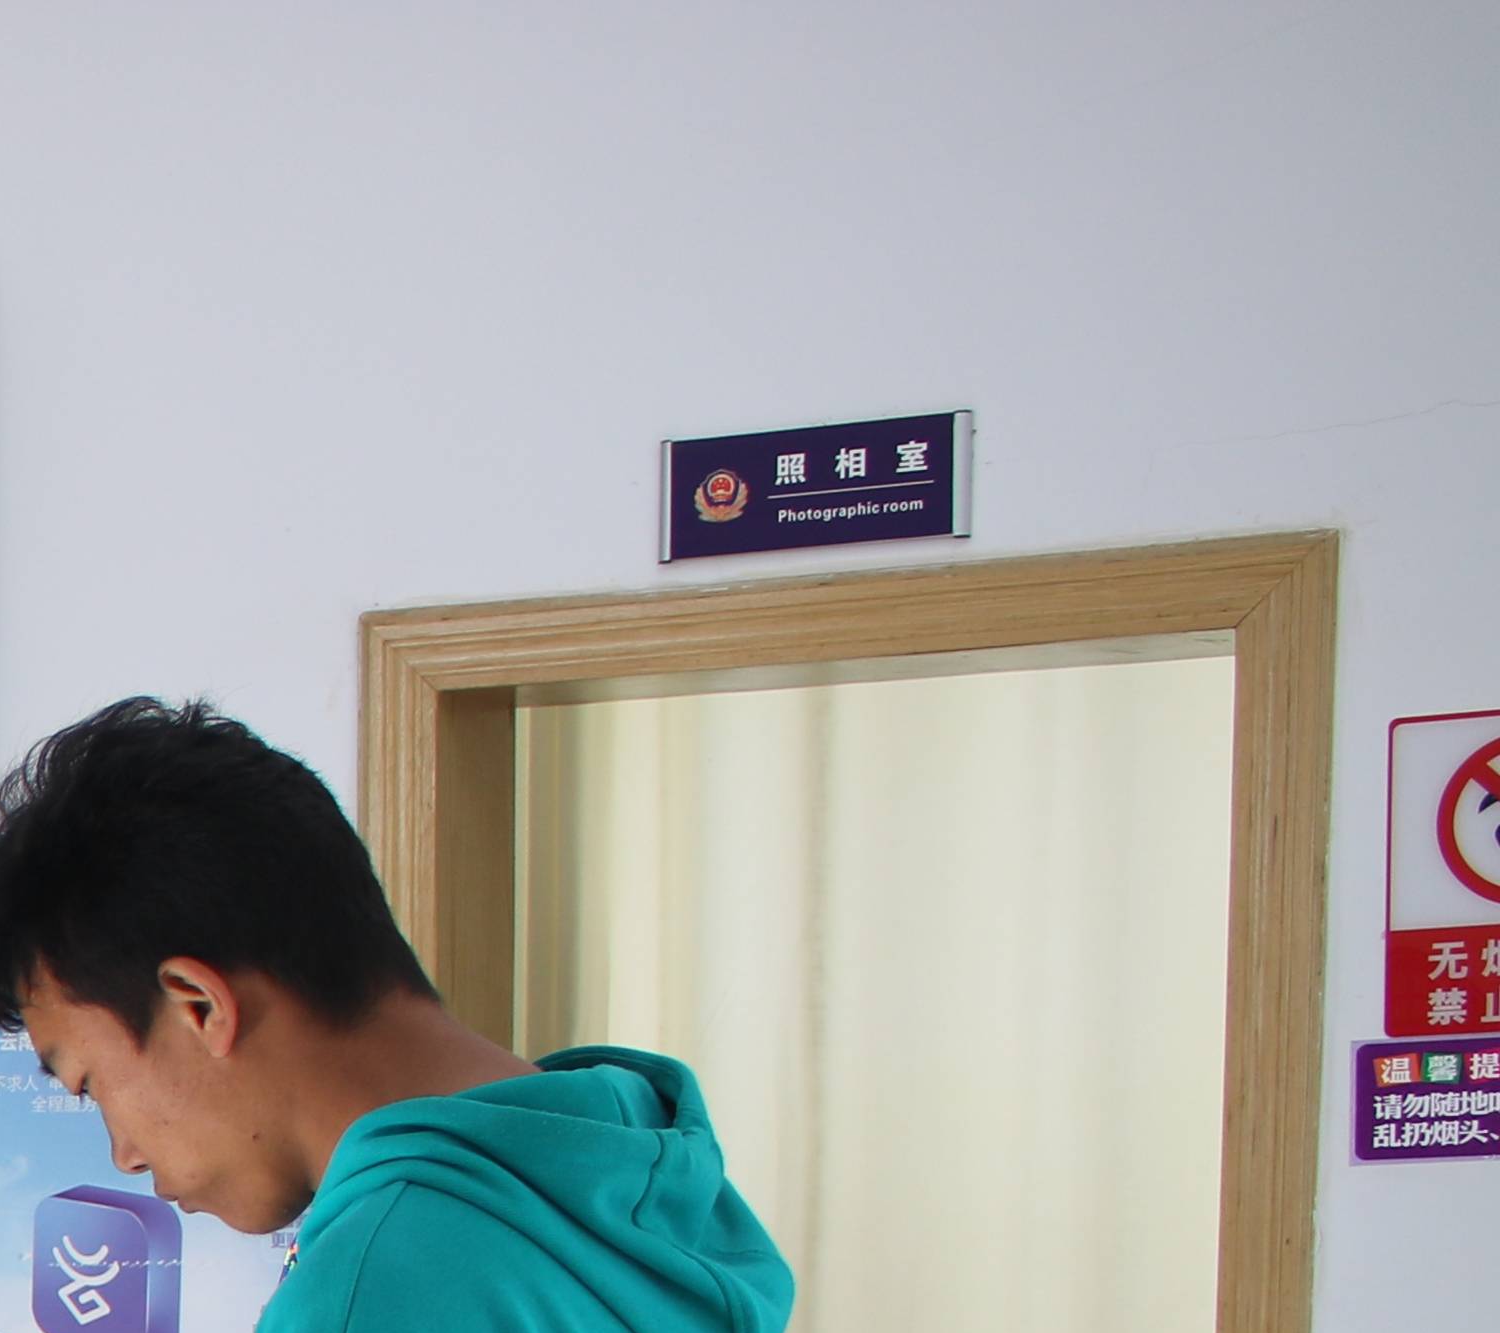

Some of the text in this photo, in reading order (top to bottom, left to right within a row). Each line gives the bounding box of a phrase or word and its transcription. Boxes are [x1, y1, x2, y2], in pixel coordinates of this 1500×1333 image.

[775, 440, 928, 485] 照相室
[778, 499, 924, 523] Photographic room
